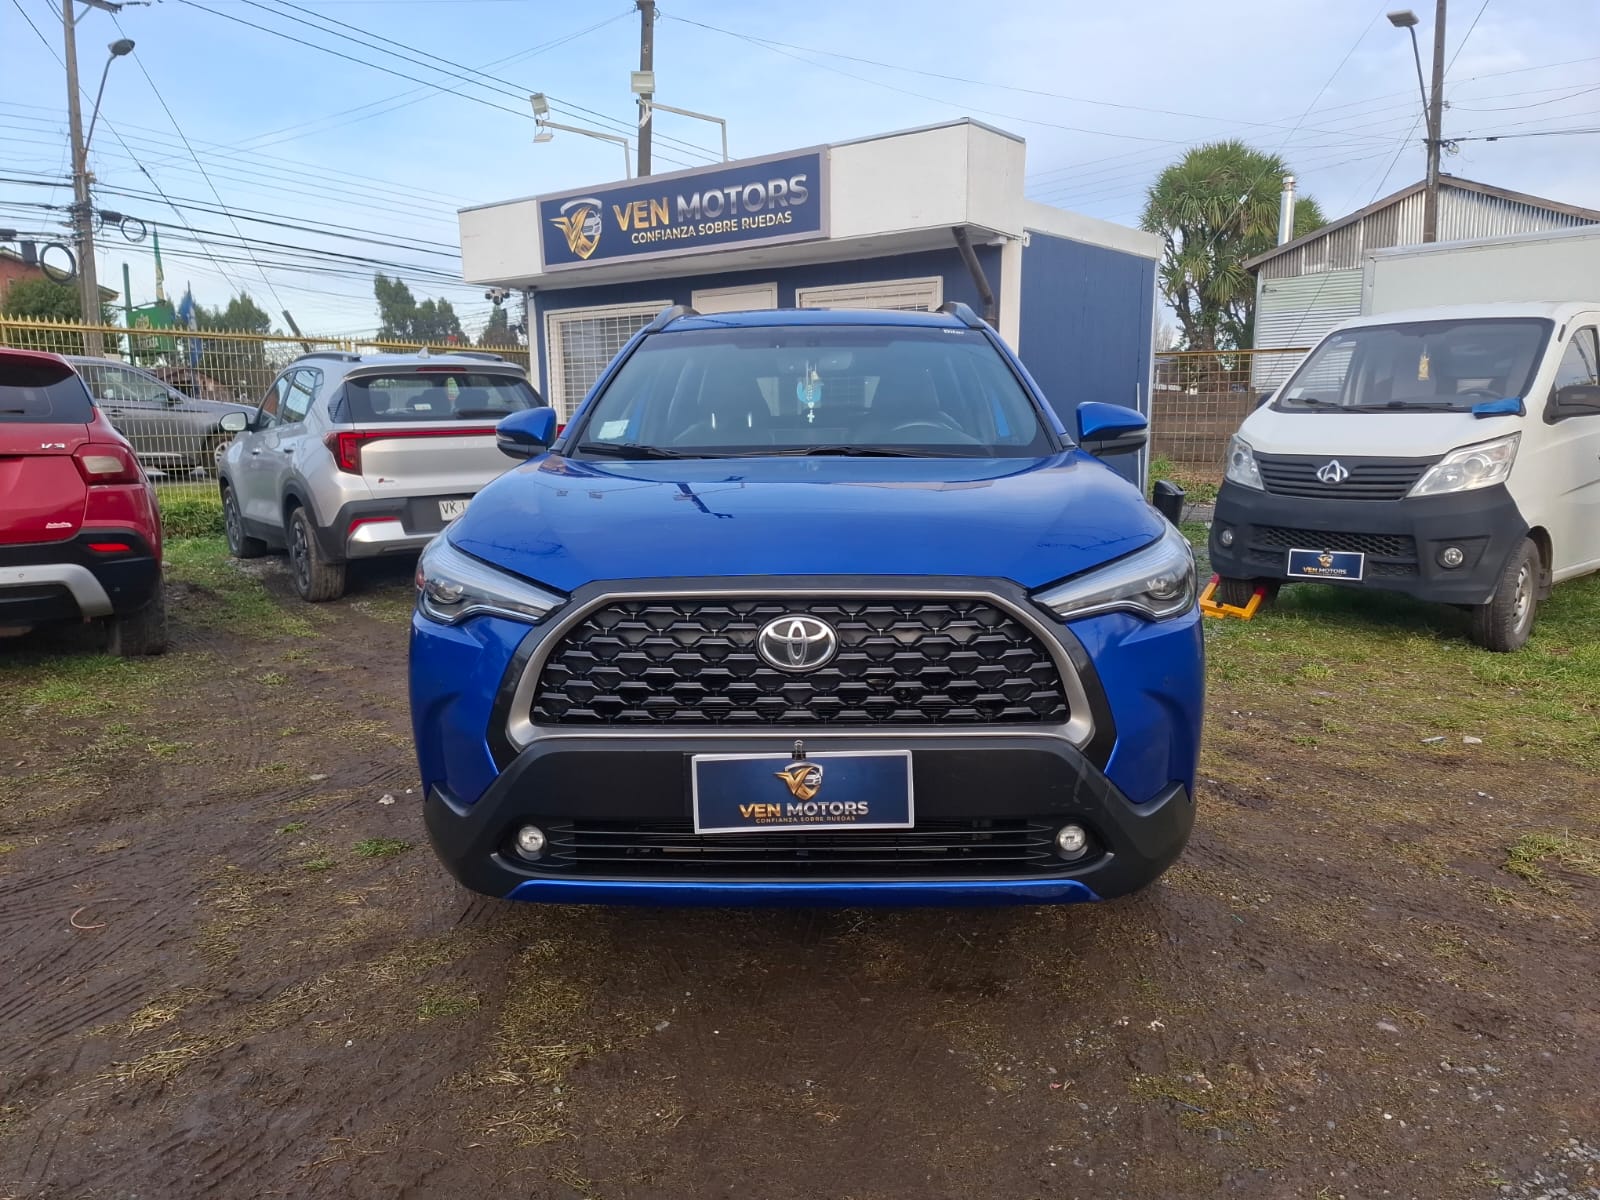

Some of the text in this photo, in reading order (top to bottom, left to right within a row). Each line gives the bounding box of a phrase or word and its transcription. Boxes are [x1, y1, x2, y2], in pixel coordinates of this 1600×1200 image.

[613, 174, 809, 232] VEN MOTORS
[631, 211, 793, 244] CONFIANZA SOBRE RUEDAS
[1303, 566, 1318, 574] VEN
[1319, 567, 1347, 575] MOTORS
[739, 801, 869, 818] VEN MOTORS
